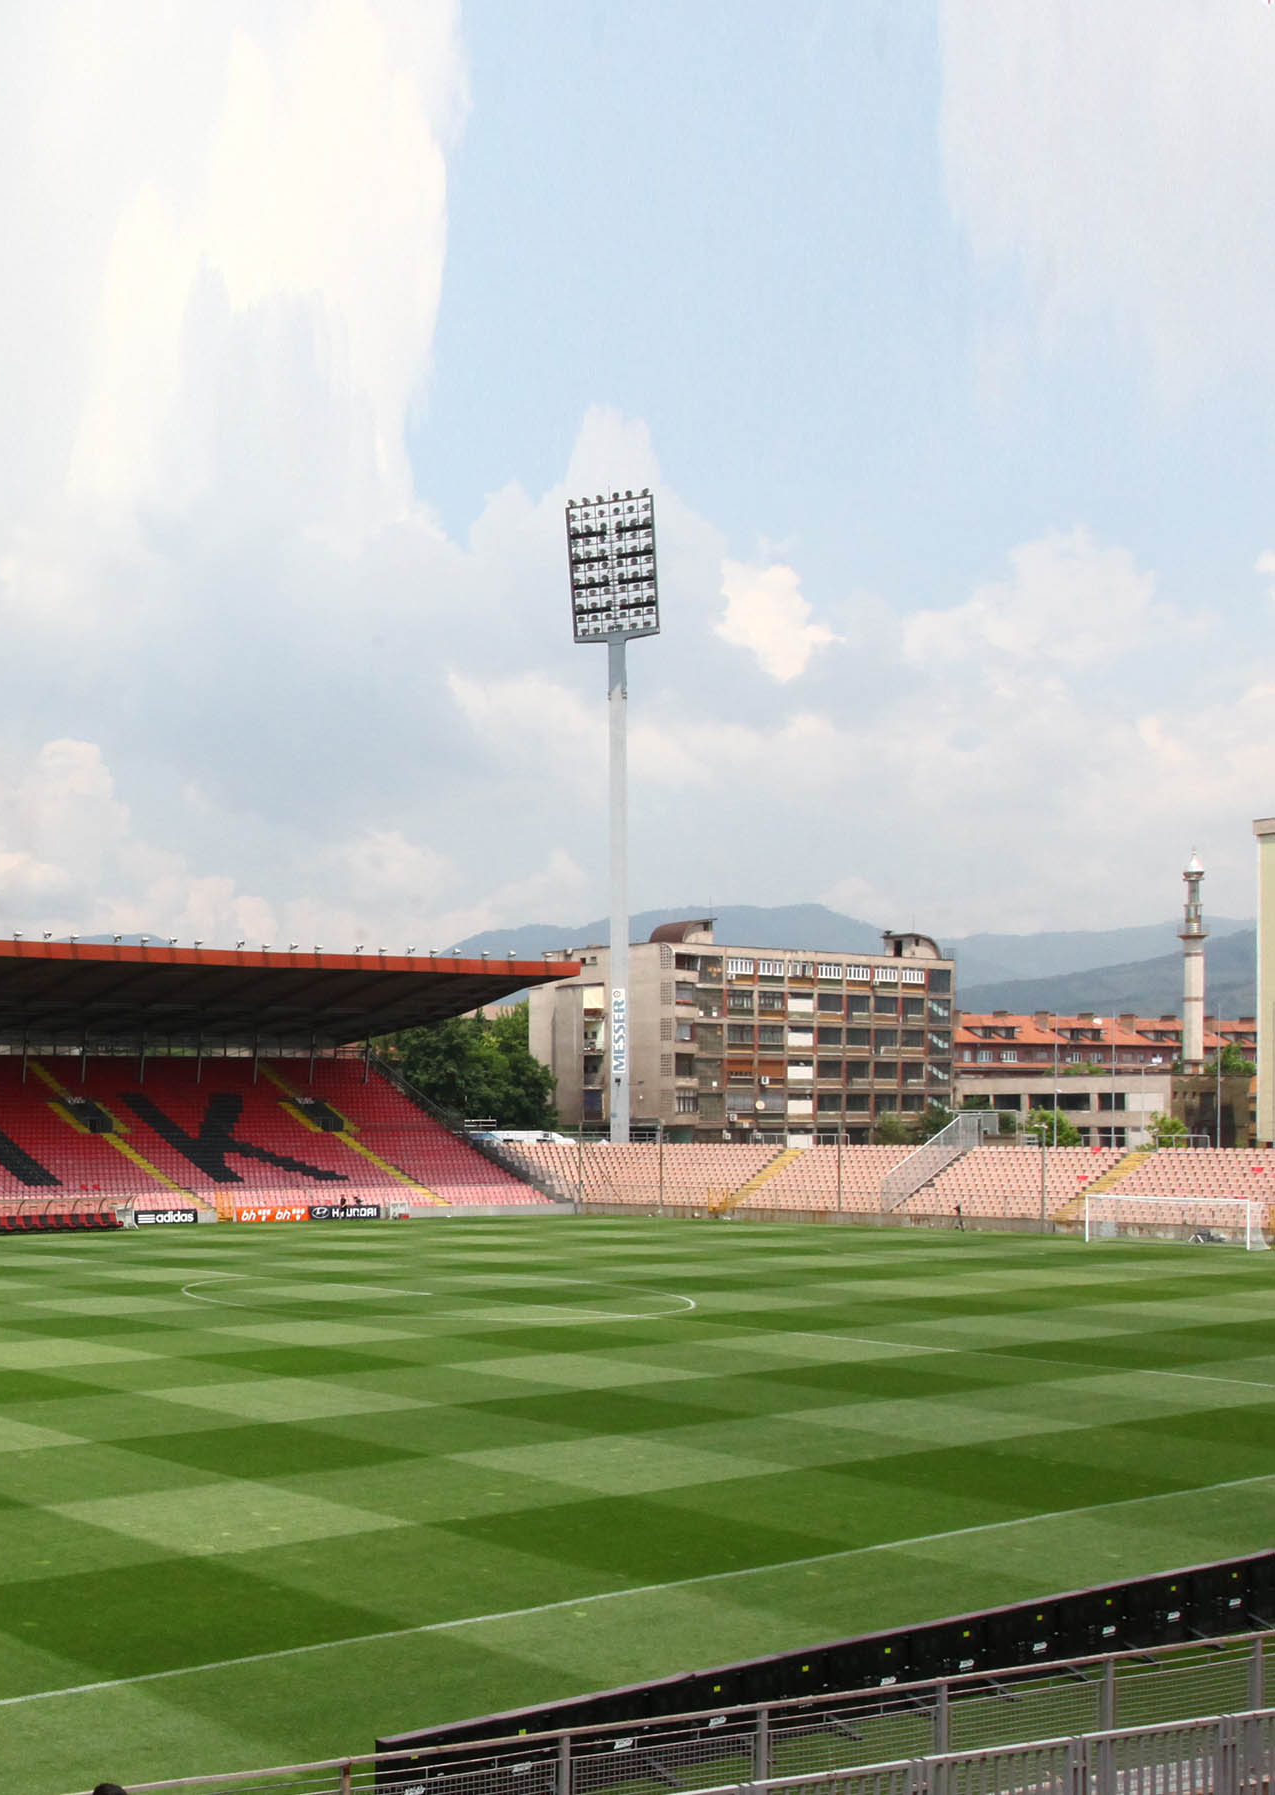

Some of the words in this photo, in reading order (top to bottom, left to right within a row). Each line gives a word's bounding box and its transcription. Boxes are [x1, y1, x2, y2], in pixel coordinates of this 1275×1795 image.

[613, 1000, 625, 1072] MESSER
[156, 1210, 194, 1224] adidas
[332, 1207, 377, 1218] HUNDAI
